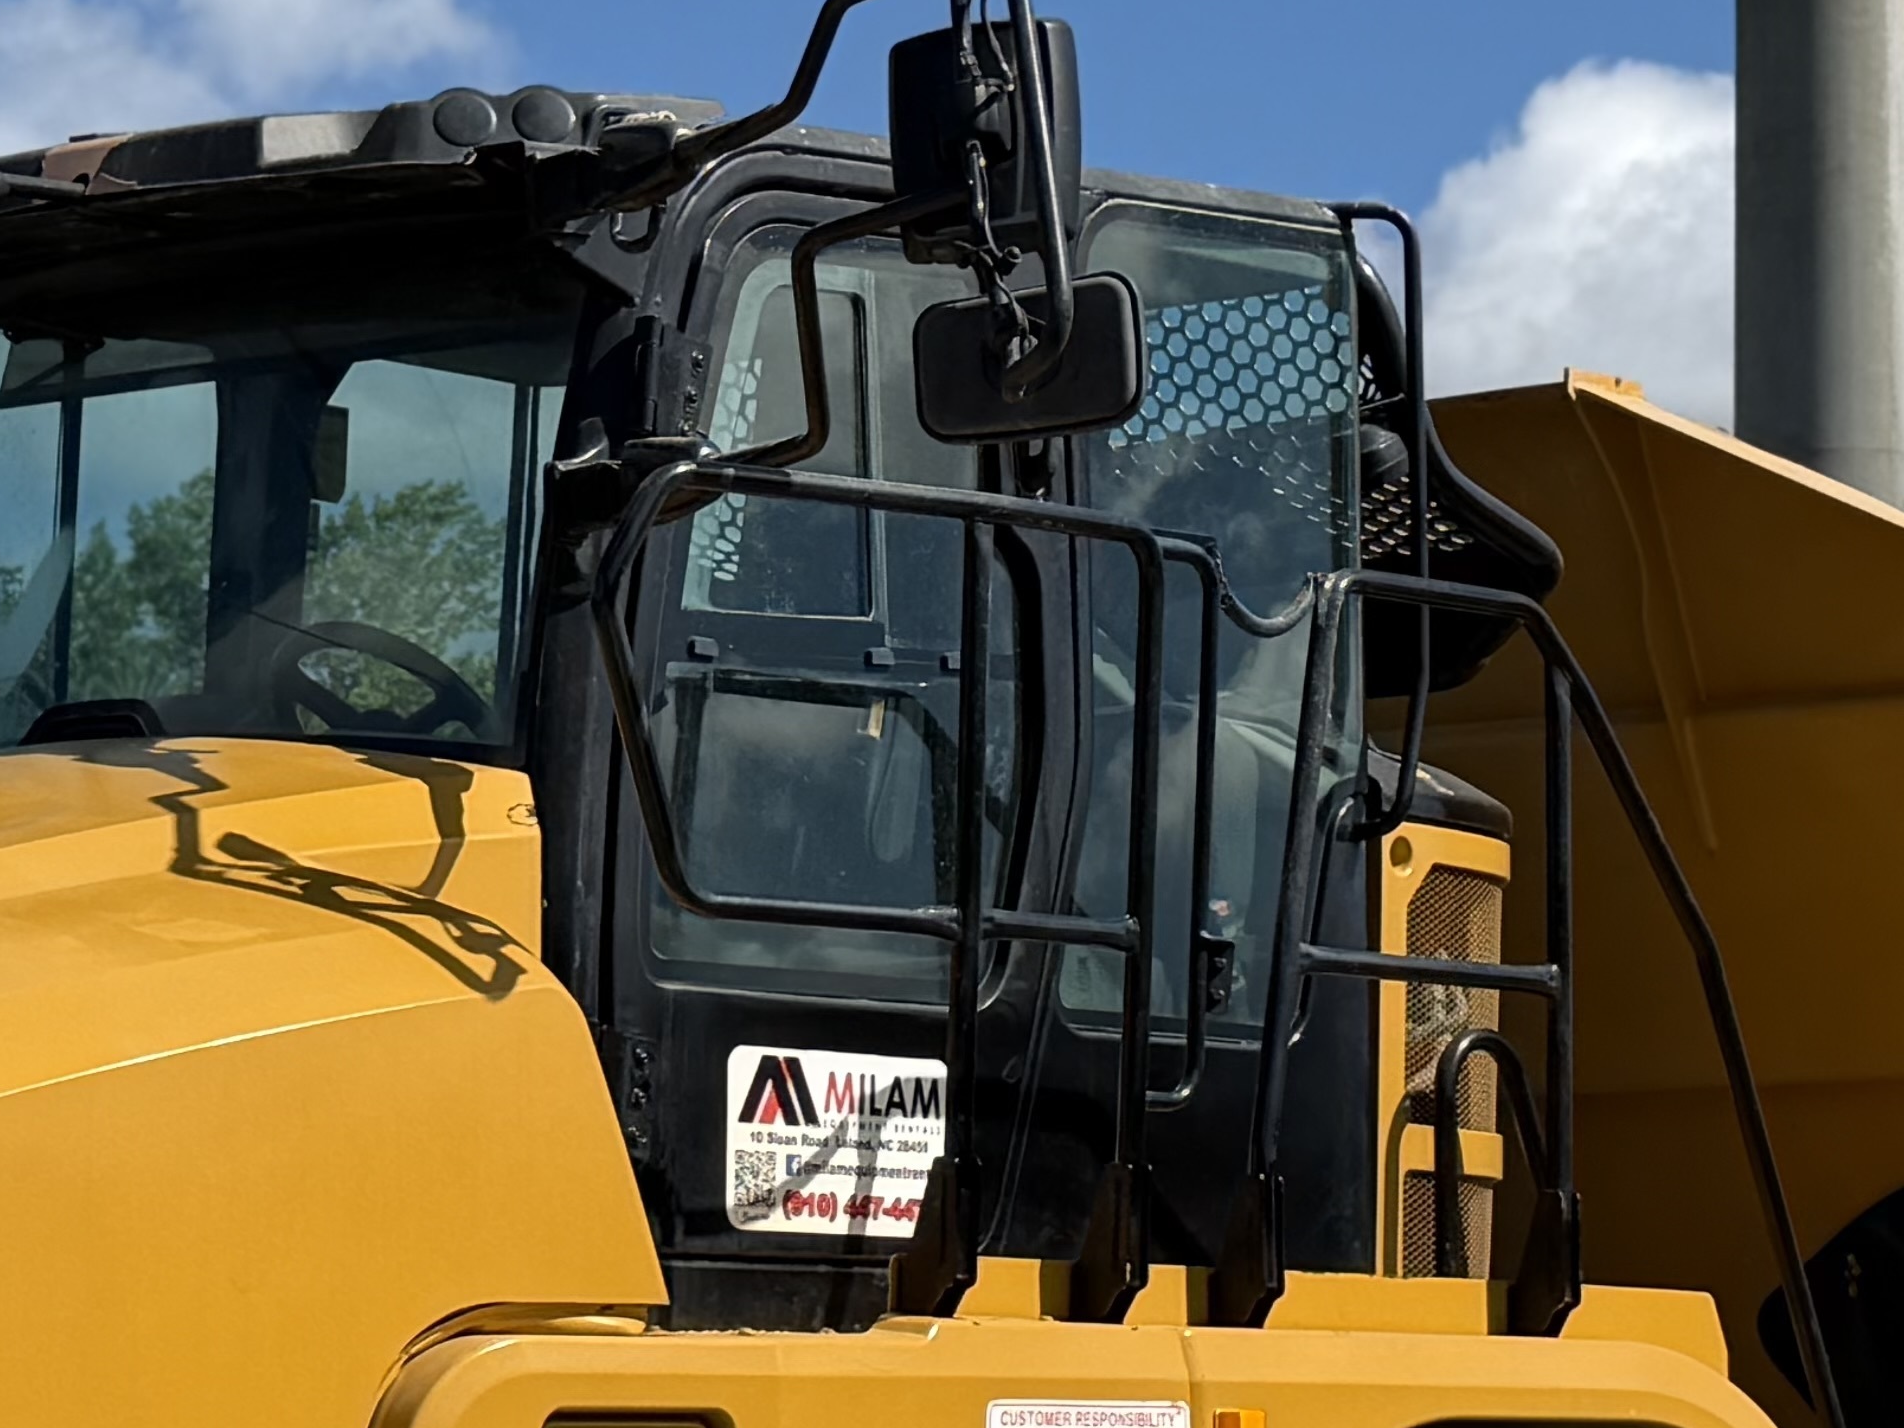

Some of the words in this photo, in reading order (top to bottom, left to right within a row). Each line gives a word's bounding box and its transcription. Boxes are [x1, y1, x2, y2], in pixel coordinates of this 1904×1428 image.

[824, 1071, 941, 1120] MILAM
[749, 1131, 765, 1143] 10
[766, 1131, 798, 1146] Sloan
[783, 1189, 839, 1223] (910)
[1000, 1410, 1073, 1427] CUSTOMER
[1075, 1411, 1175, 1428] RESPONSIBILITY
